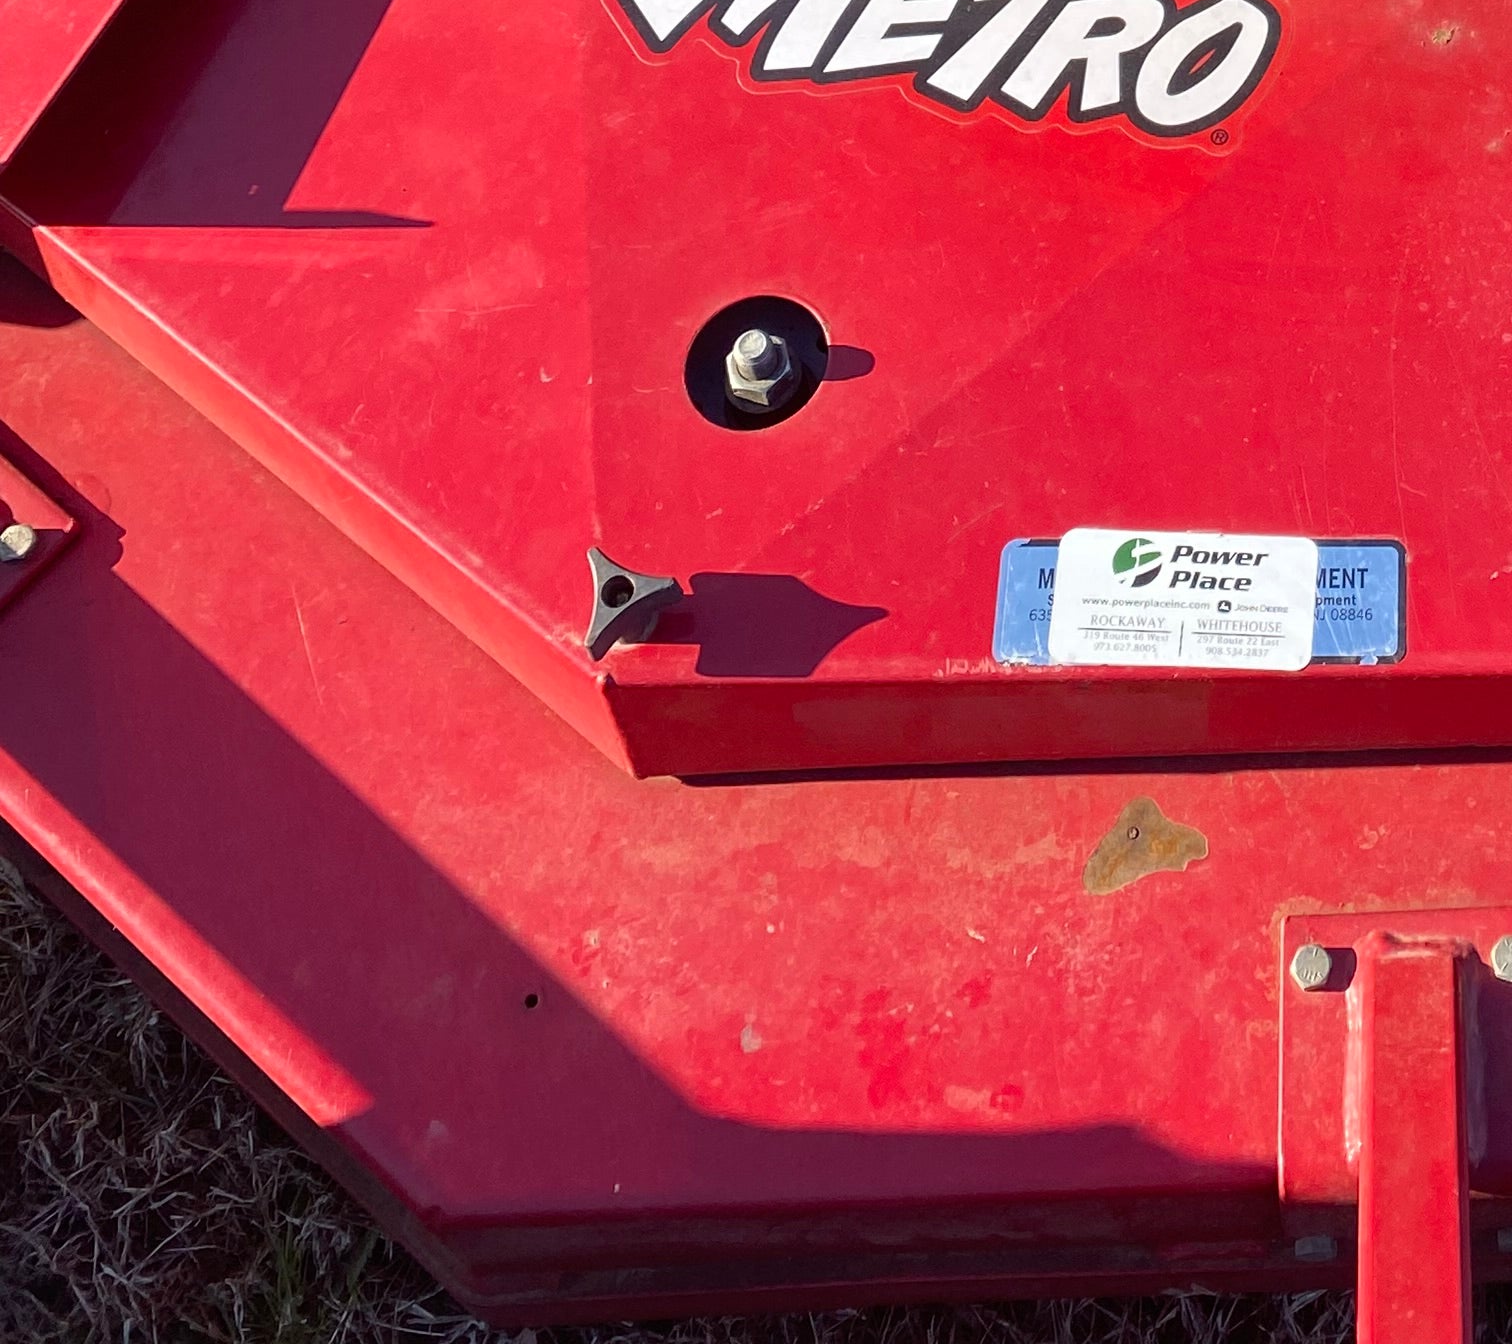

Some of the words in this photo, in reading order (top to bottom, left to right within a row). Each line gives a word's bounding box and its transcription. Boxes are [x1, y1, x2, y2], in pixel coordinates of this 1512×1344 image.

[1169, 545, 1269, 566] Power
[1168, 570, 1252, 591] Place
[1316, 567, 1369, 589] MENT
[1082, 597, 1210, 610] www.powerplaceinc.com
[1315, 594, 1357, 608] pment
[1090, 614, 1166, 629] ROCKAWAY
[1330, 608, 1373, 621] 08846
[1197, 618, 1282, 632] WHITEHOUSE
[1103, 631, 1130, 640] Route
[1217, 636, 1243, 645] Route
